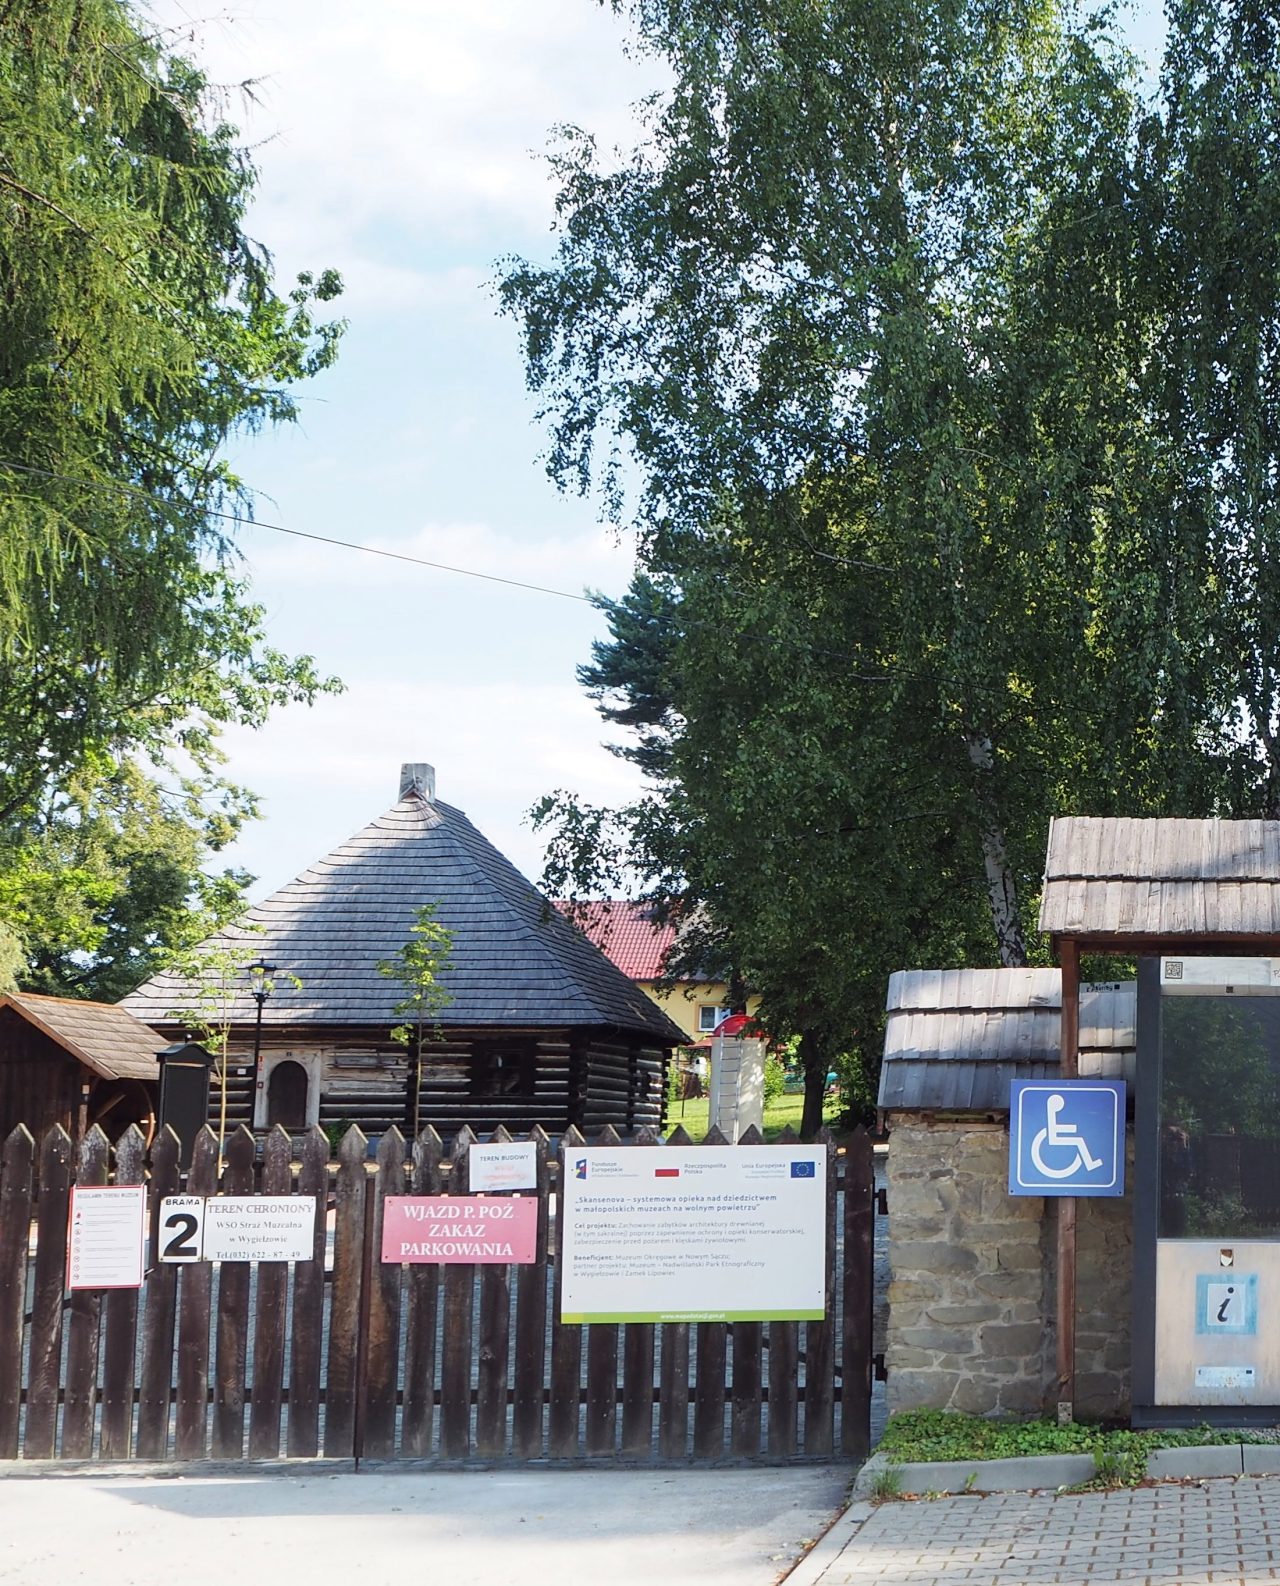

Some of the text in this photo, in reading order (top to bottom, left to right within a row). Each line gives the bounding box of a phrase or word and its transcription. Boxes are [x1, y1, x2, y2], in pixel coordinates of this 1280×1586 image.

[165, 1198, 200, 1206] BRAMA
[208, 1204, 313, 1213] TEREN CHRONIONY
[403, 1205, 460, 1220] WJAZD
[464, 1205, 475, 1219] P.
[217, 1221, 238, 1229] WSO
[429, 1224, 486, 1238] ZAKAZ
[163, 1213, 198, 1257] 2
[400, 1242, 514, 1256] PARKOWANIA
